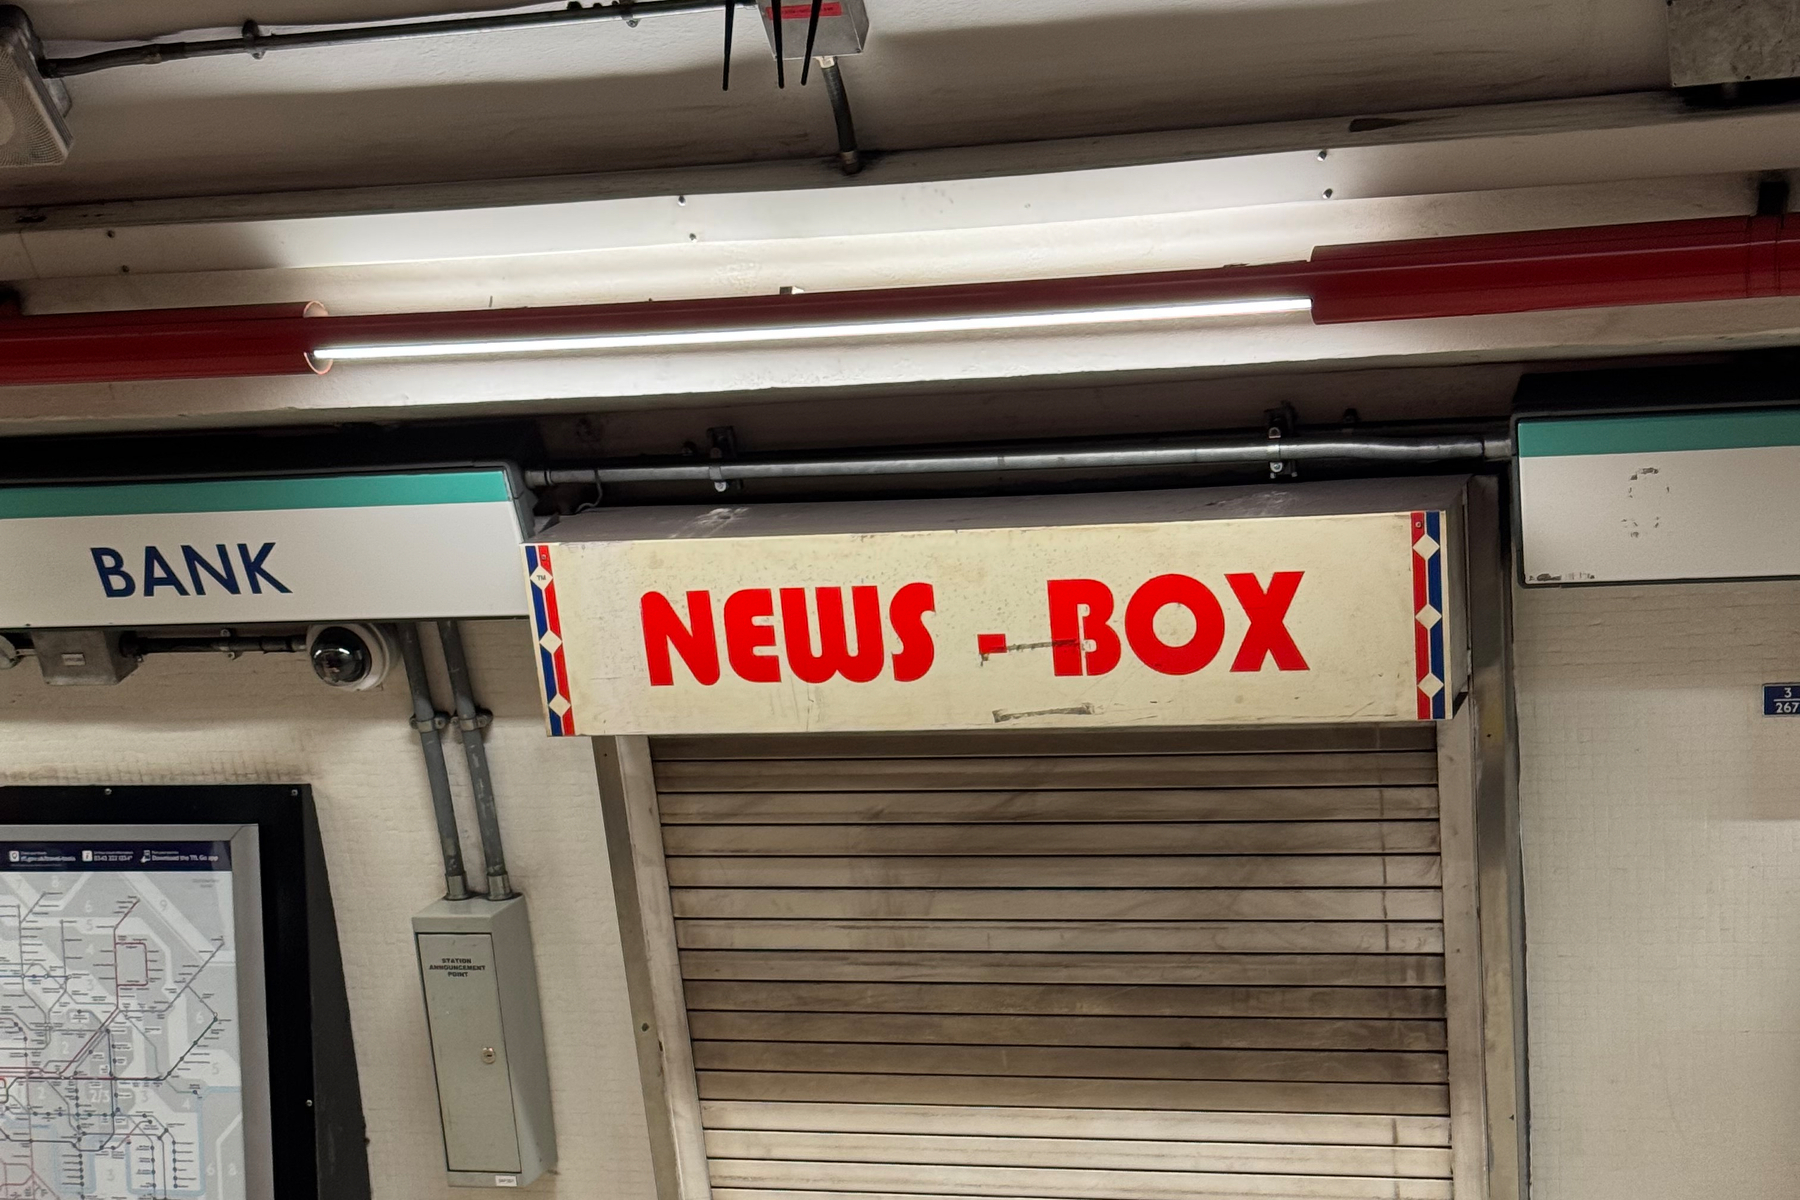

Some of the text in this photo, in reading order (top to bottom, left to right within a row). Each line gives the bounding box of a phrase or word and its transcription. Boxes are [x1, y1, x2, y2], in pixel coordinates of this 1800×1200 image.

[91, 541, 292, 599] BANK
[536, 574, 547, 582] TM
[641, 582, 935, 687] NEWS
[1047, 570, 1310, 676] BOX
[1784, 687, 1793, 698] 3
[1775, 702, 1800, 714] 267
